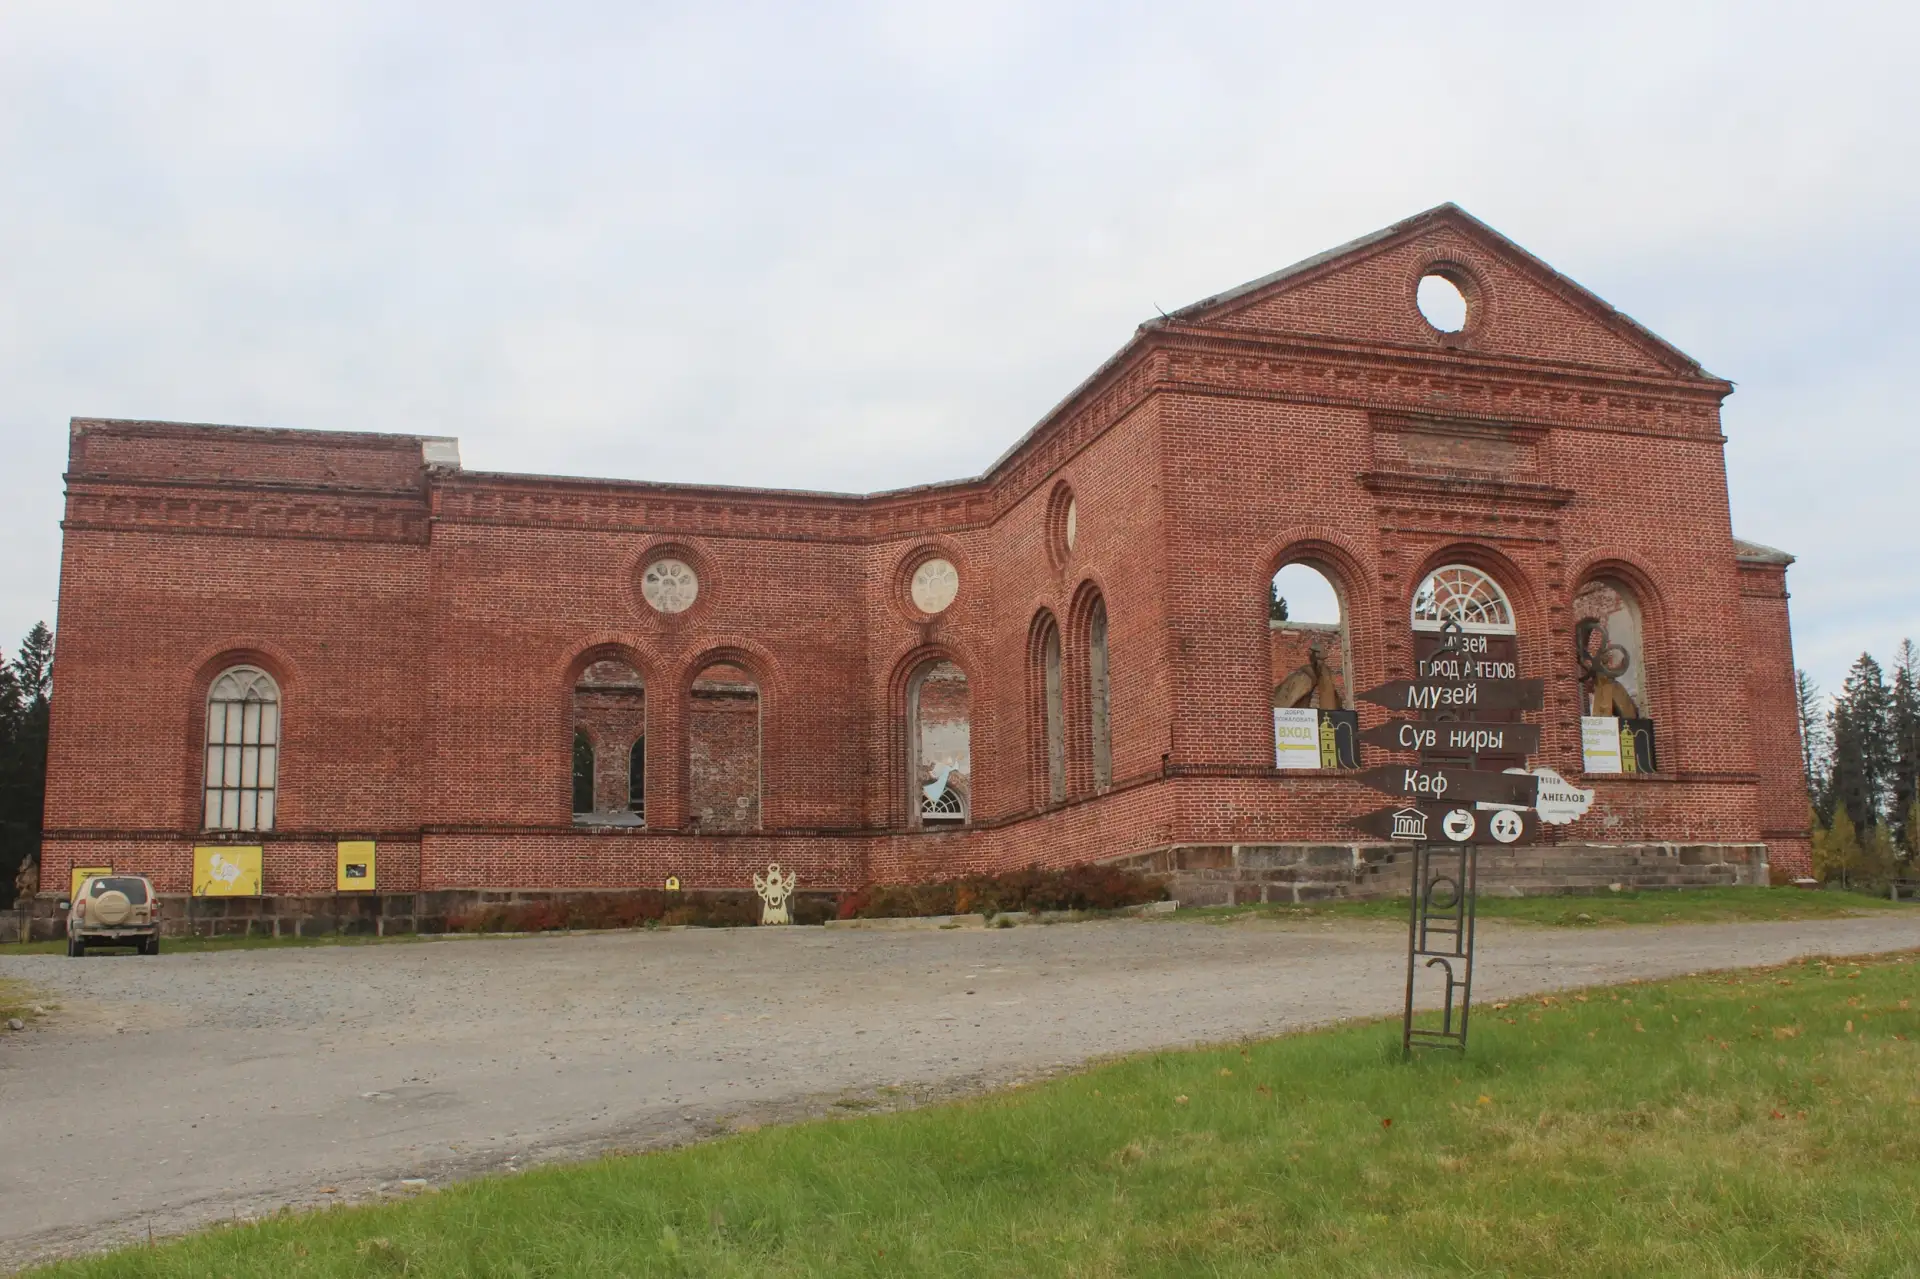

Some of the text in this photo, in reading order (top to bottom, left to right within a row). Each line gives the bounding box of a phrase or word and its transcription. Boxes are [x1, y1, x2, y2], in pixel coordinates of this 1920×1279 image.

[1444, 636, 1487, 655] зей
[1407, 683, 1477, 709] Музей
[1279, 726, 1312, 740] ВХОД
[1541, 793, 1585, 802] АНГЕЛОВ
